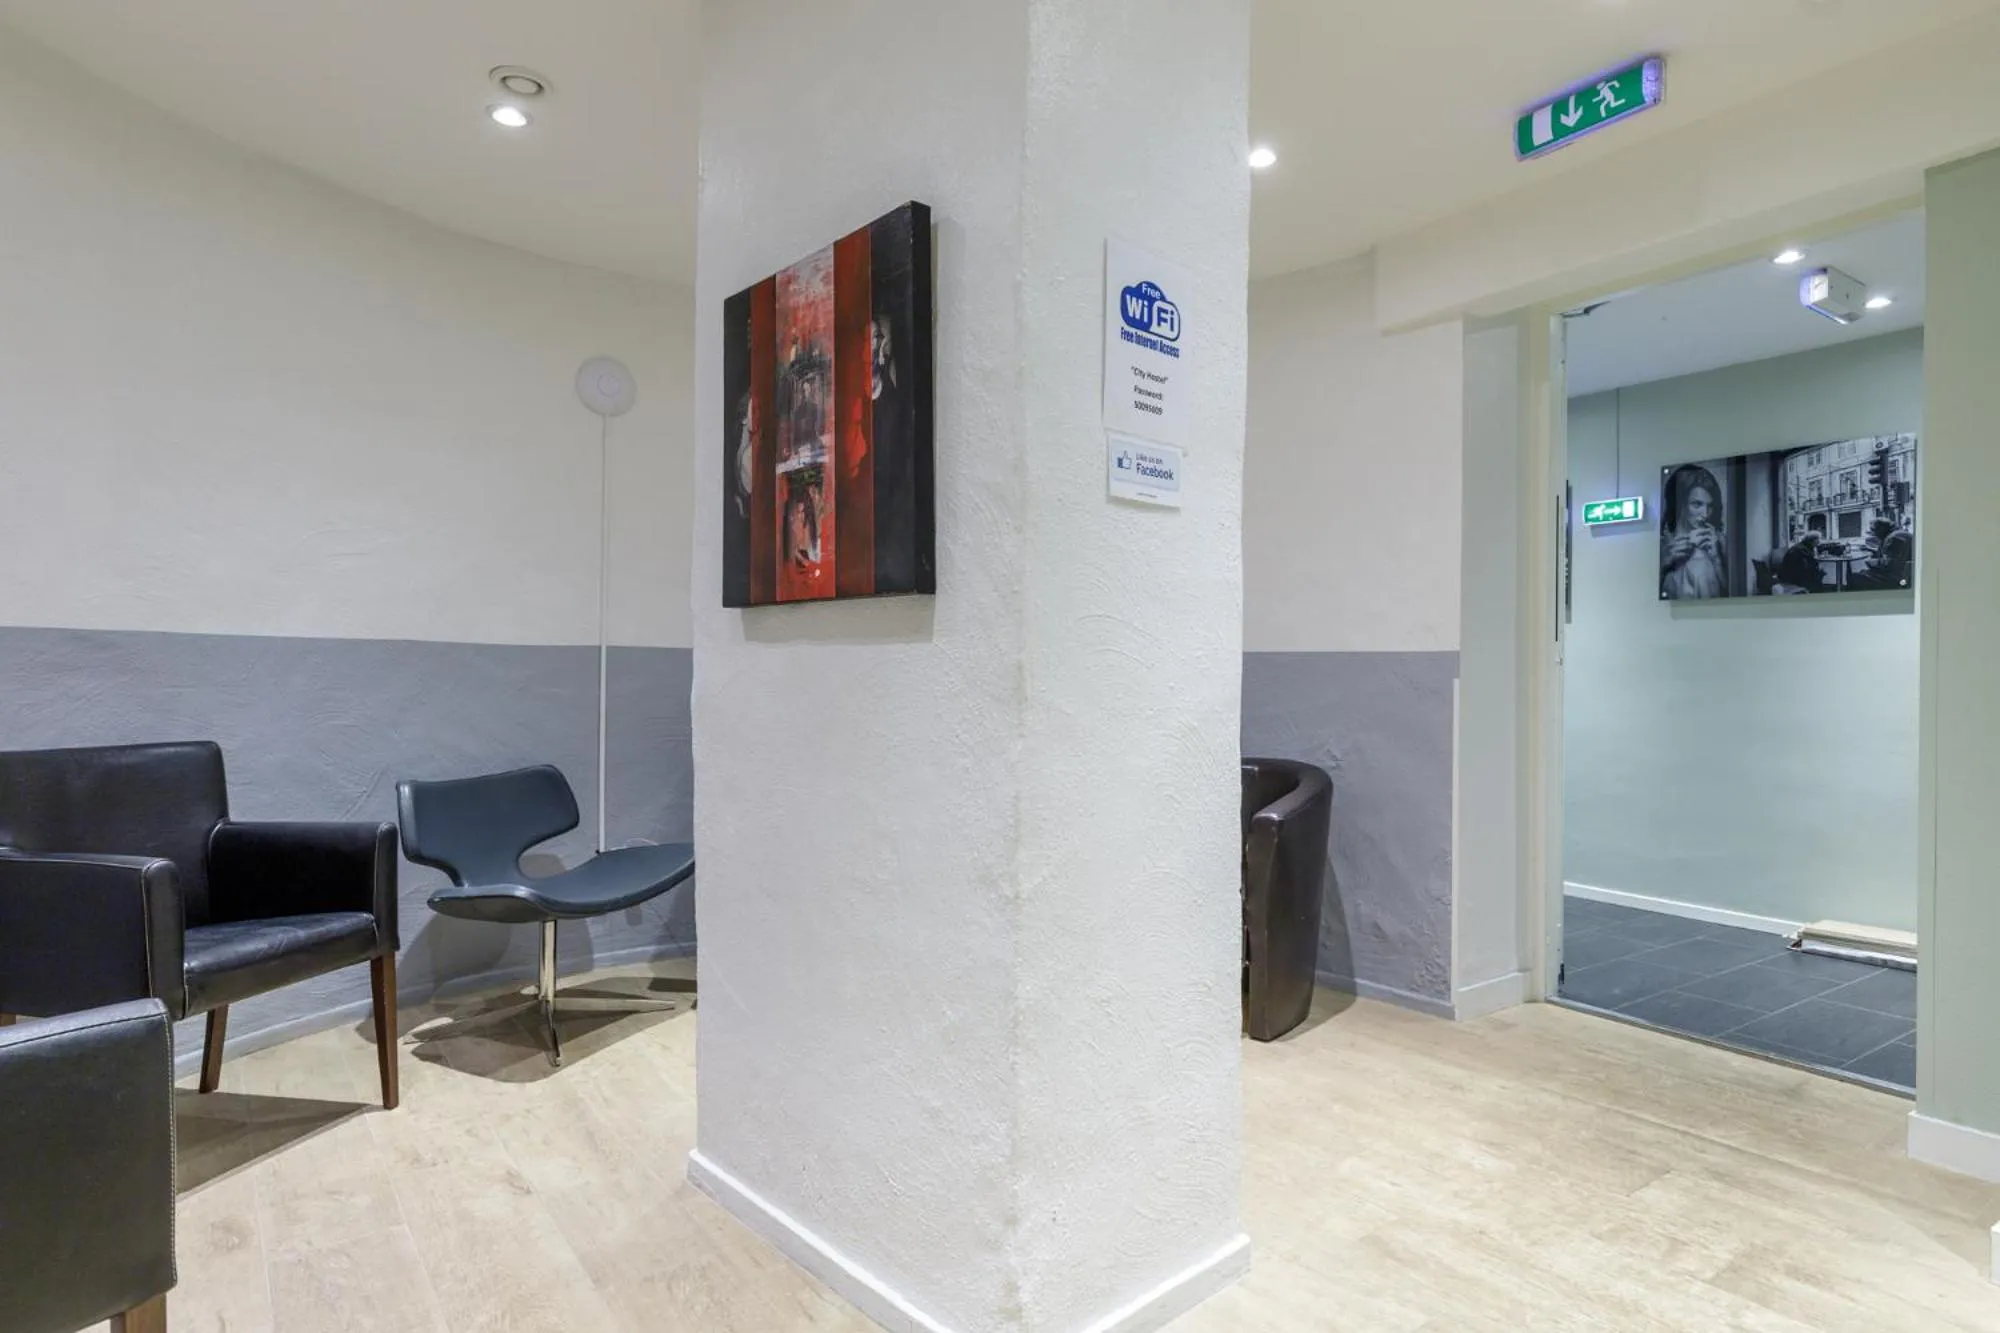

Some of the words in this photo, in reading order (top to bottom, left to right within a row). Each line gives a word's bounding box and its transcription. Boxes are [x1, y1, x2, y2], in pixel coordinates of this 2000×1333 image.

[1142, 283, 1161, 299] Free
[1120, 326, 1134, 343] Free
[1135, 332, 1159, 350] Internet
[1160, 340, 1180, 359] Access
[1136, 463, 1174, 481] Facebook
